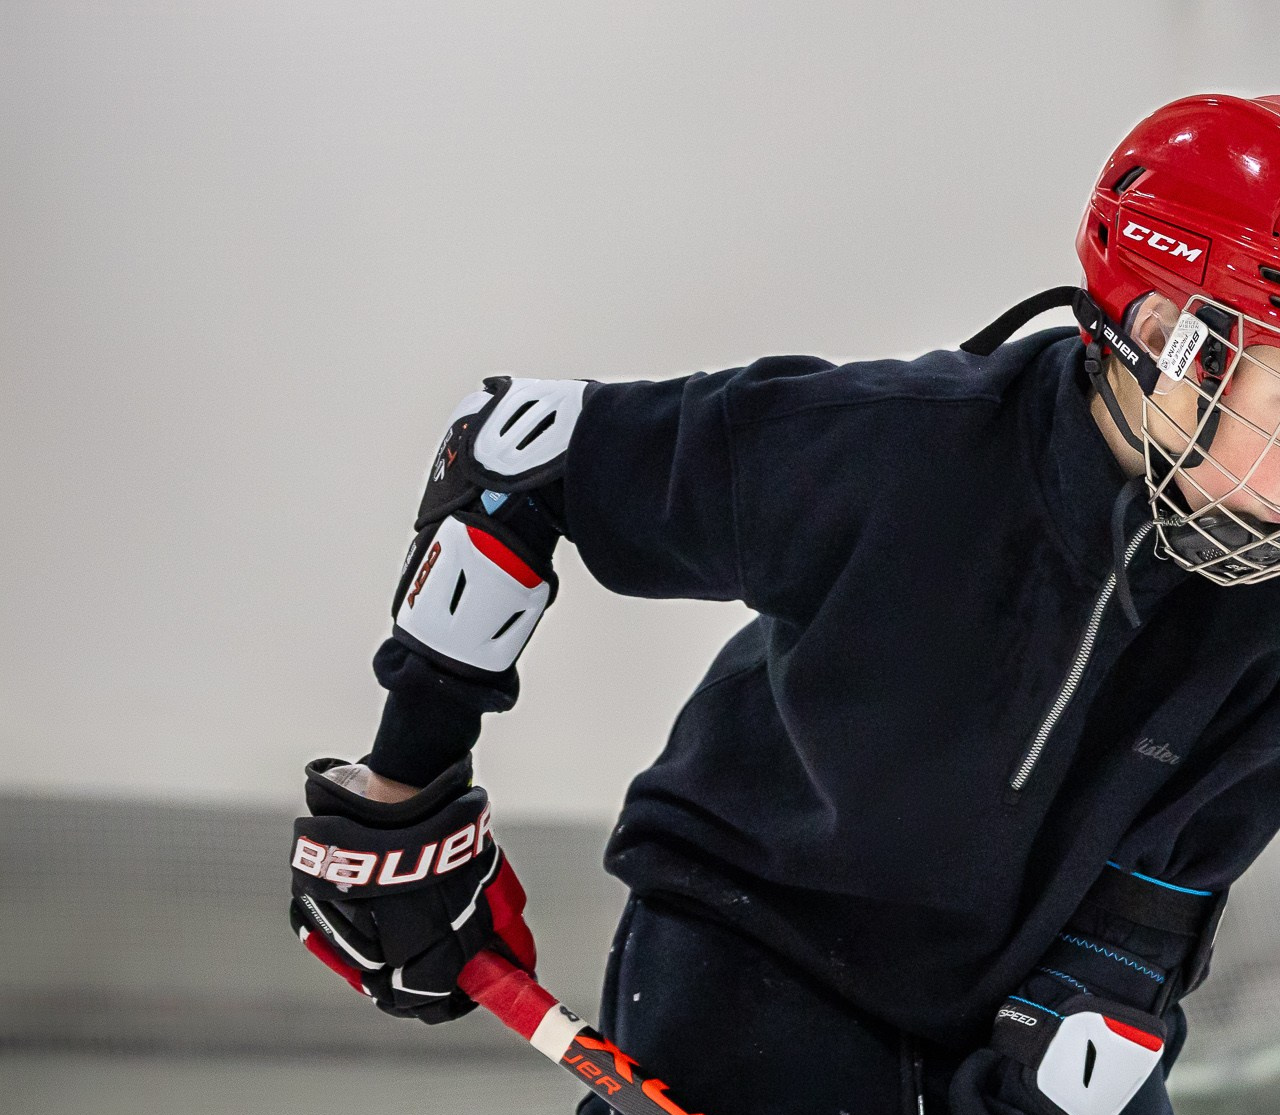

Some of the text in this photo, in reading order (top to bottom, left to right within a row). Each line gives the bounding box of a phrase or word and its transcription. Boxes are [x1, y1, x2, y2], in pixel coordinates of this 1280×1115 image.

[1121, 220, 1203, 264] CCM
[1103, 324, 1140, 366] AUER
[998, 1008, 1038, 1027] SPEED
[562, 1046, 622, 1096] UER
